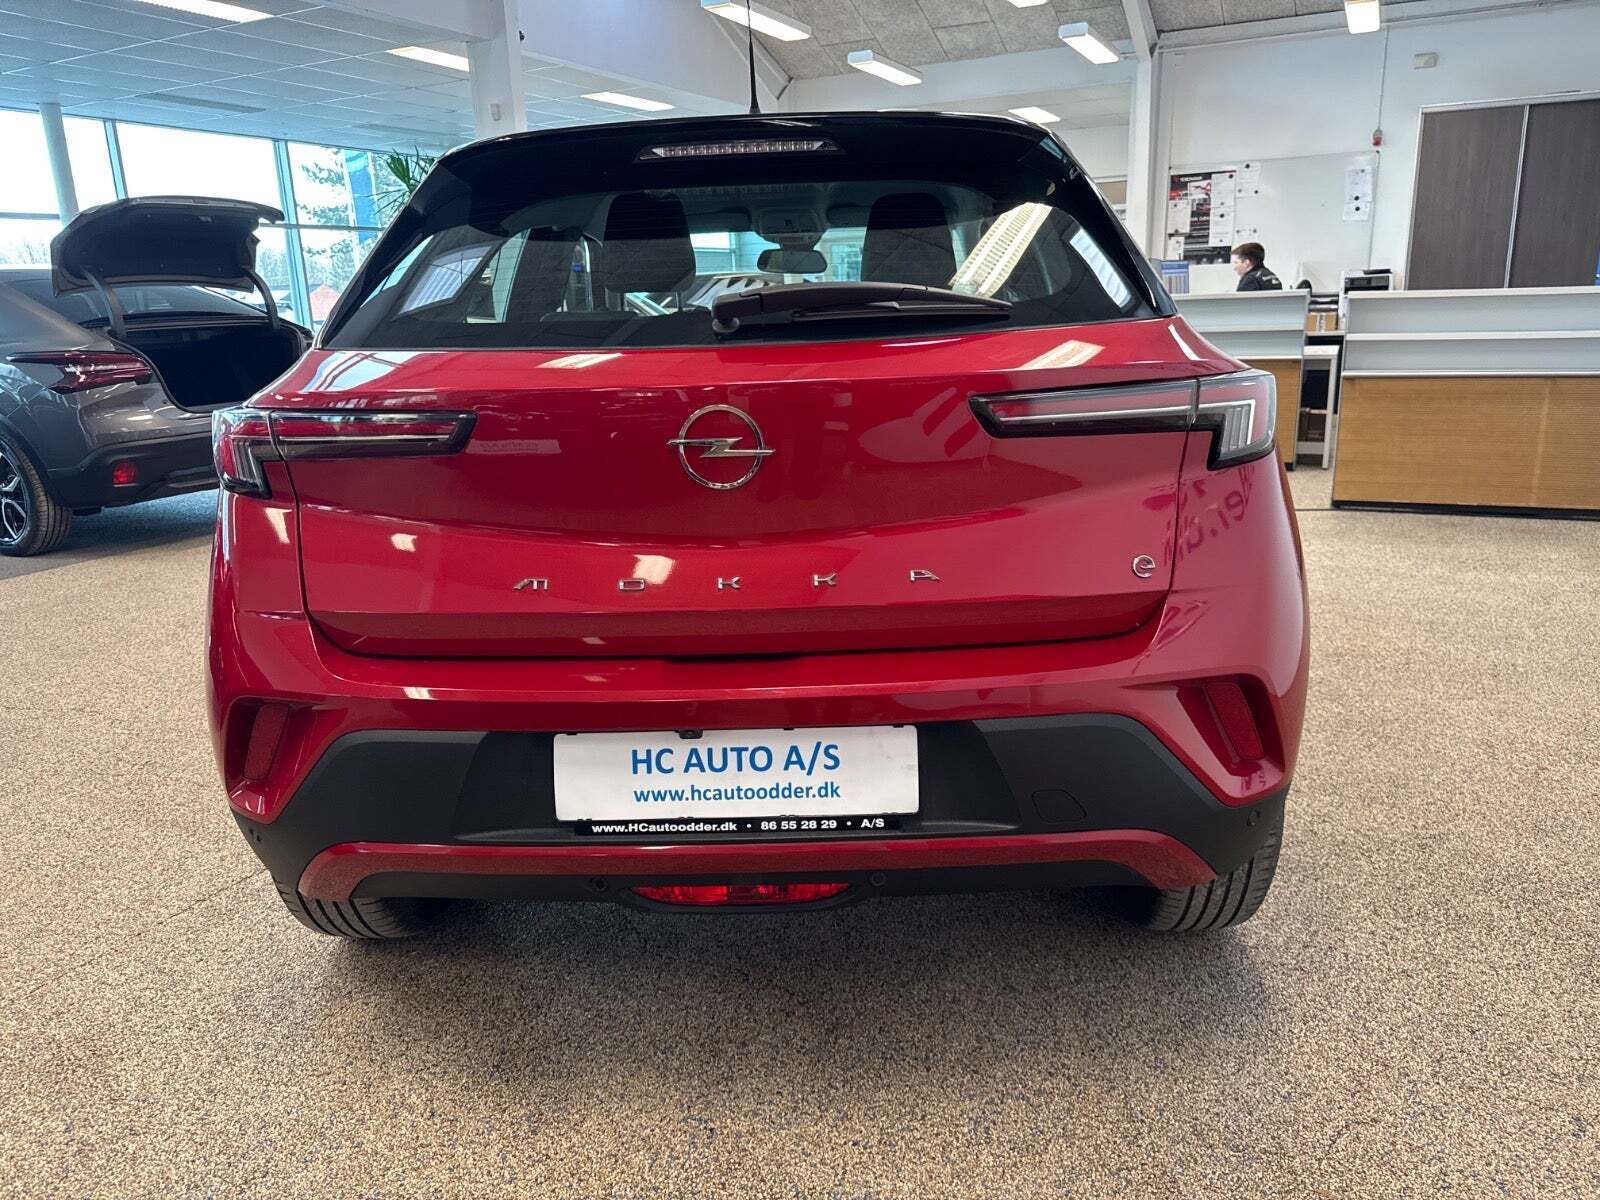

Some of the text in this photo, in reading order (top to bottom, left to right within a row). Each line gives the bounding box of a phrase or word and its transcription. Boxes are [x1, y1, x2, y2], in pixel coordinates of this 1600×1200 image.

[512, 568, 940, 592] MOKKA
[631, 741, 841, 776] HC AUTO A/S
[633, 781, 841, 802] www.hcautoodder.dk
[591, 818, 885, 833] www.HCautoodder.dk 86 55 28 29 A/S
